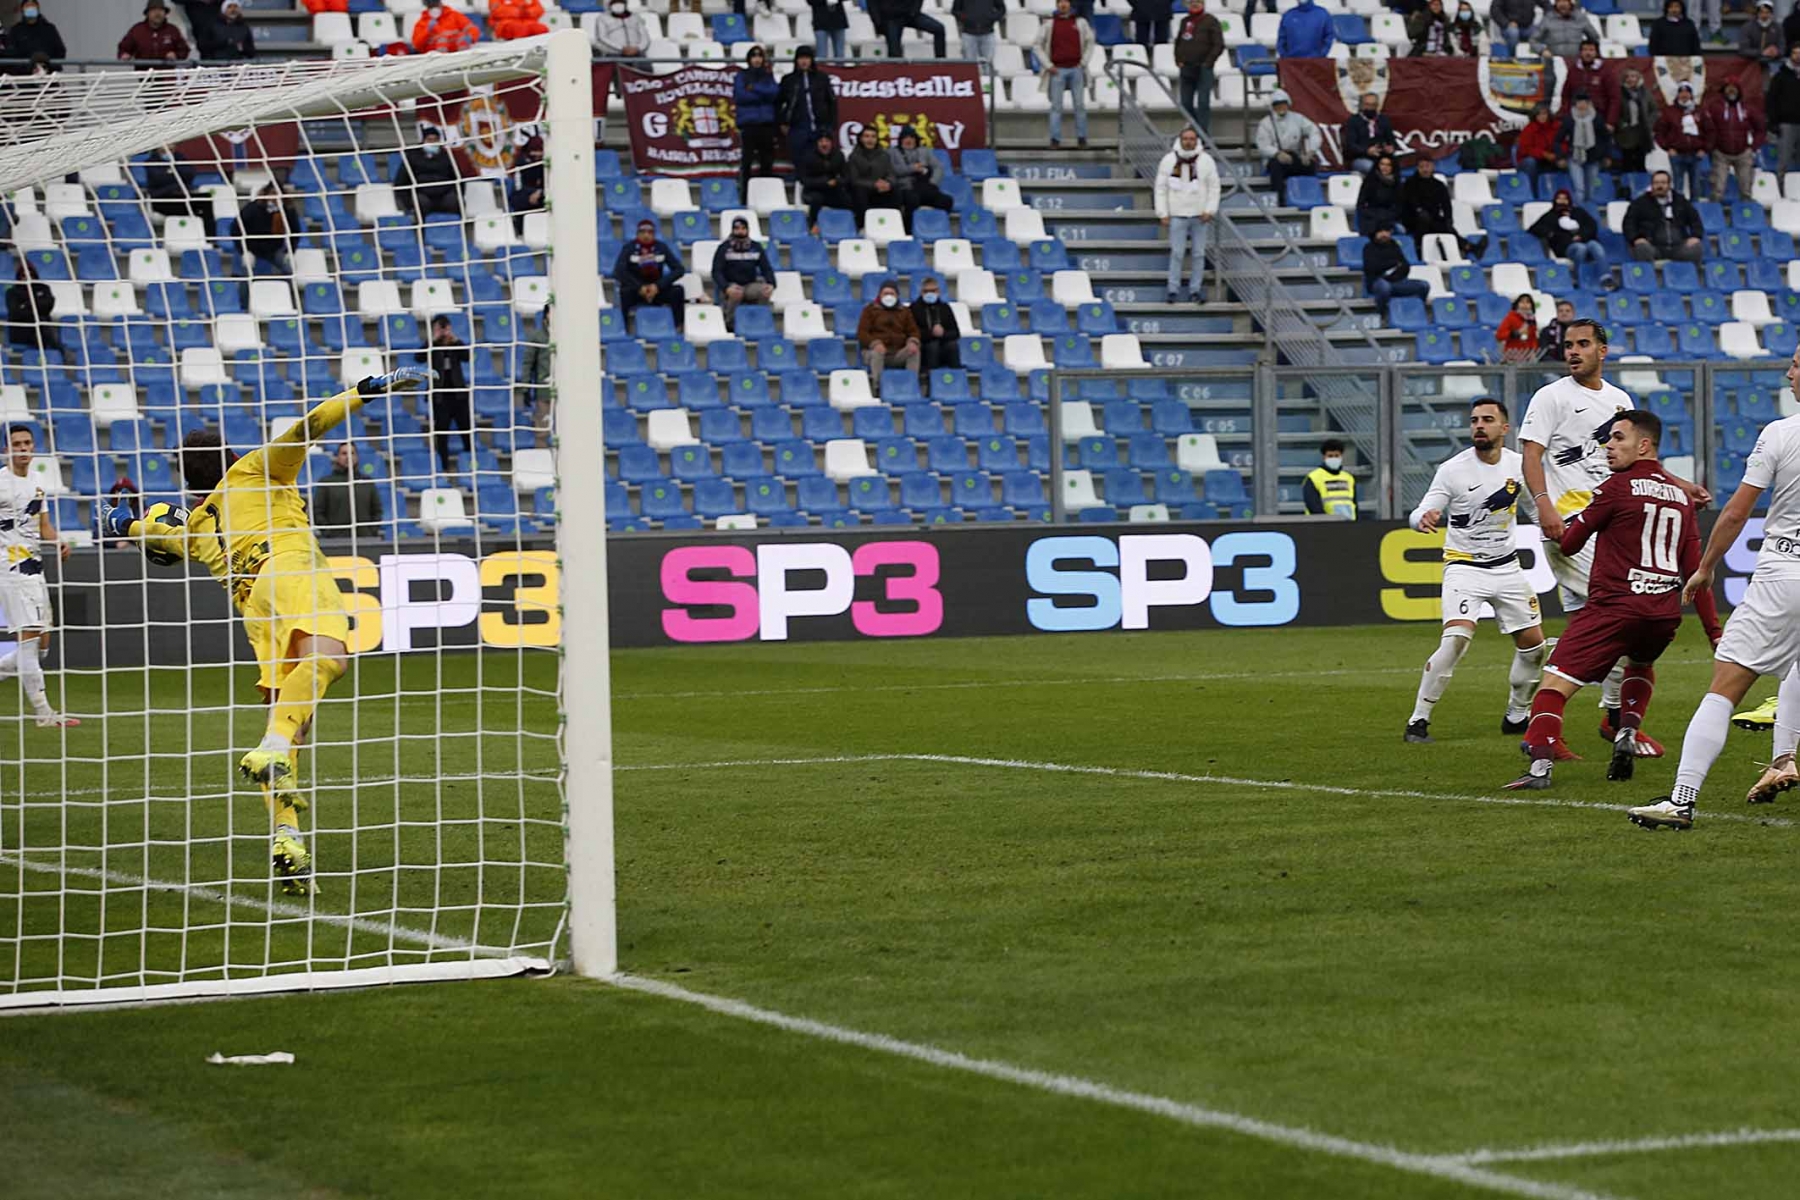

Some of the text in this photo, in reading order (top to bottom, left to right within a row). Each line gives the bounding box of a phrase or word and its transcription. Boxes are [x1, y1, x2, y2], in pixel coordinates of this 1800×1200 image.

[642, 112, 668, 138] G
[1154, 353, 1183, 366] C 07
[1180, 386, 1189, 399] C
[1206, 420, 1214, 432] C
[1640, 502, 1682, 572] 10
[661, 541, 943, 643] SP3
[1025, 532, 1300, 632] SP3
[1459, 599, 1469, 615] 6
